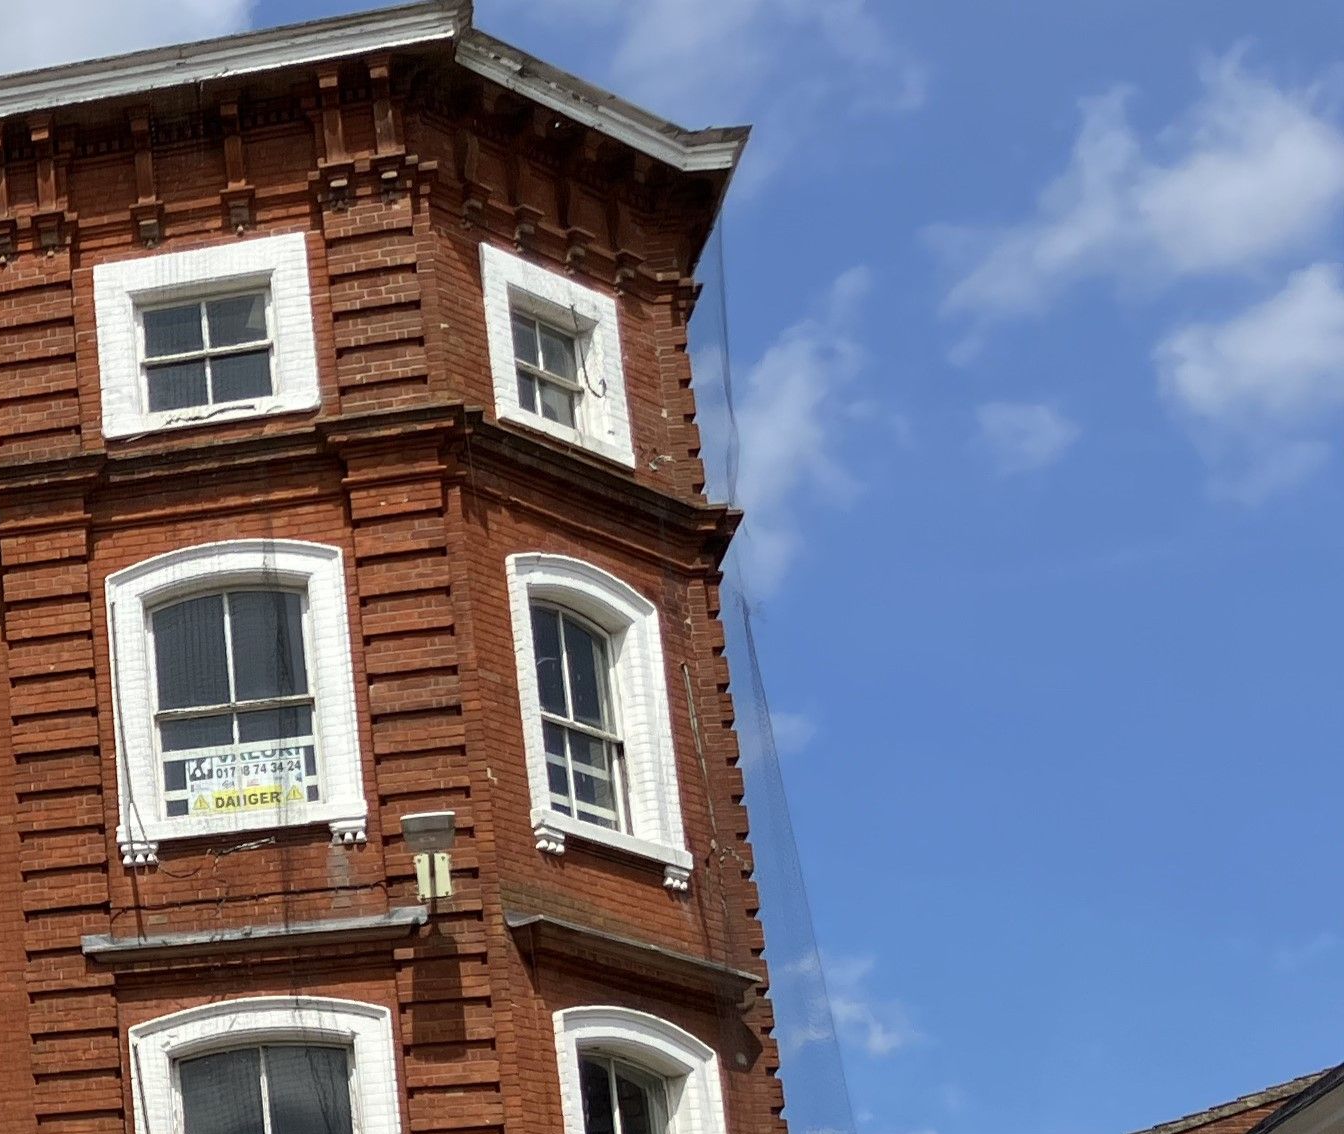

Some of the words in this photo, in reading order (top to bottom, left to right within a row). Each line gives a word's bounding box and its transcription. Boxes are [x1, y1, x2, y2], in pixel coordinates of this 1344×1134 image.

[216, 765, 250, 779] 0178
[254, 763, 266, 774] 74
[270, 761, 284, 773] 34
[287, 759, 302, 771] 24
